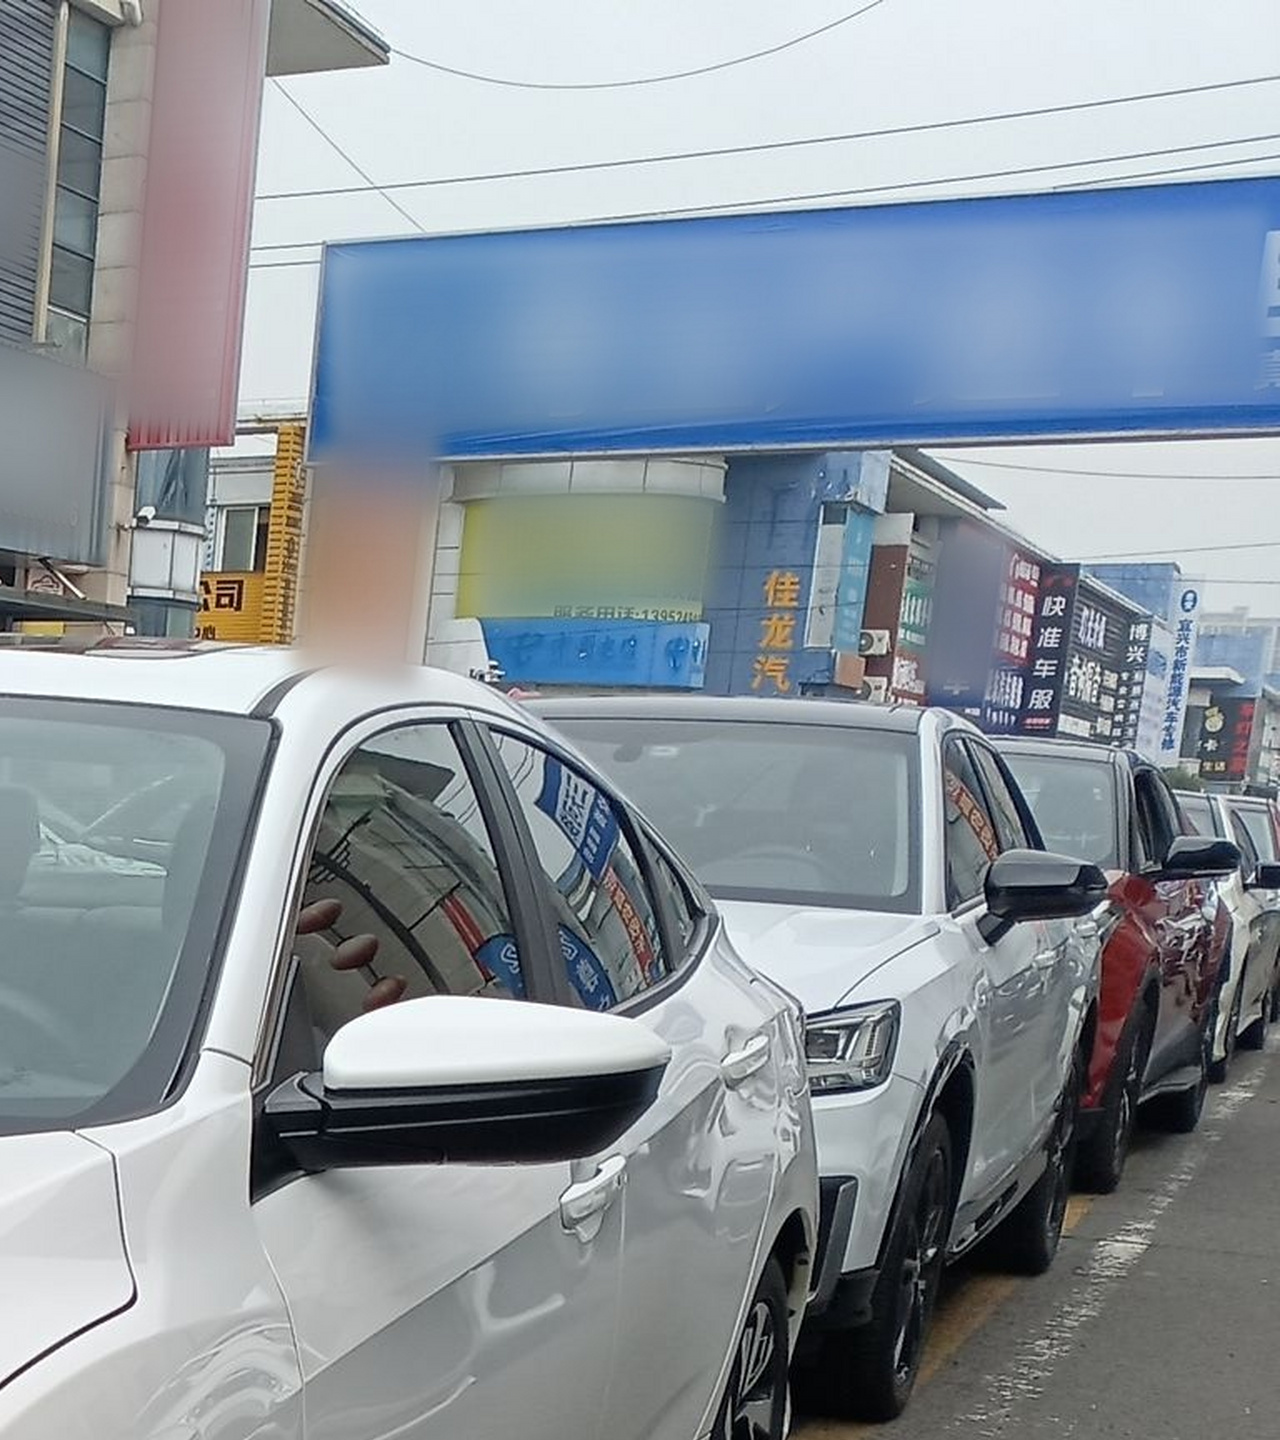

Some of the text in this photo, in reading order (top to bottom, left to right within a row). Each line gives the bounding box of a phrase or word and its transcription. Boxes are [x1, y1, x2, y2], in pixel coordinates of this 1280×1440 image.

[751, 570, 800, 693] 佳龙汽
[1027, 595, 1066, 710] 快准车服
